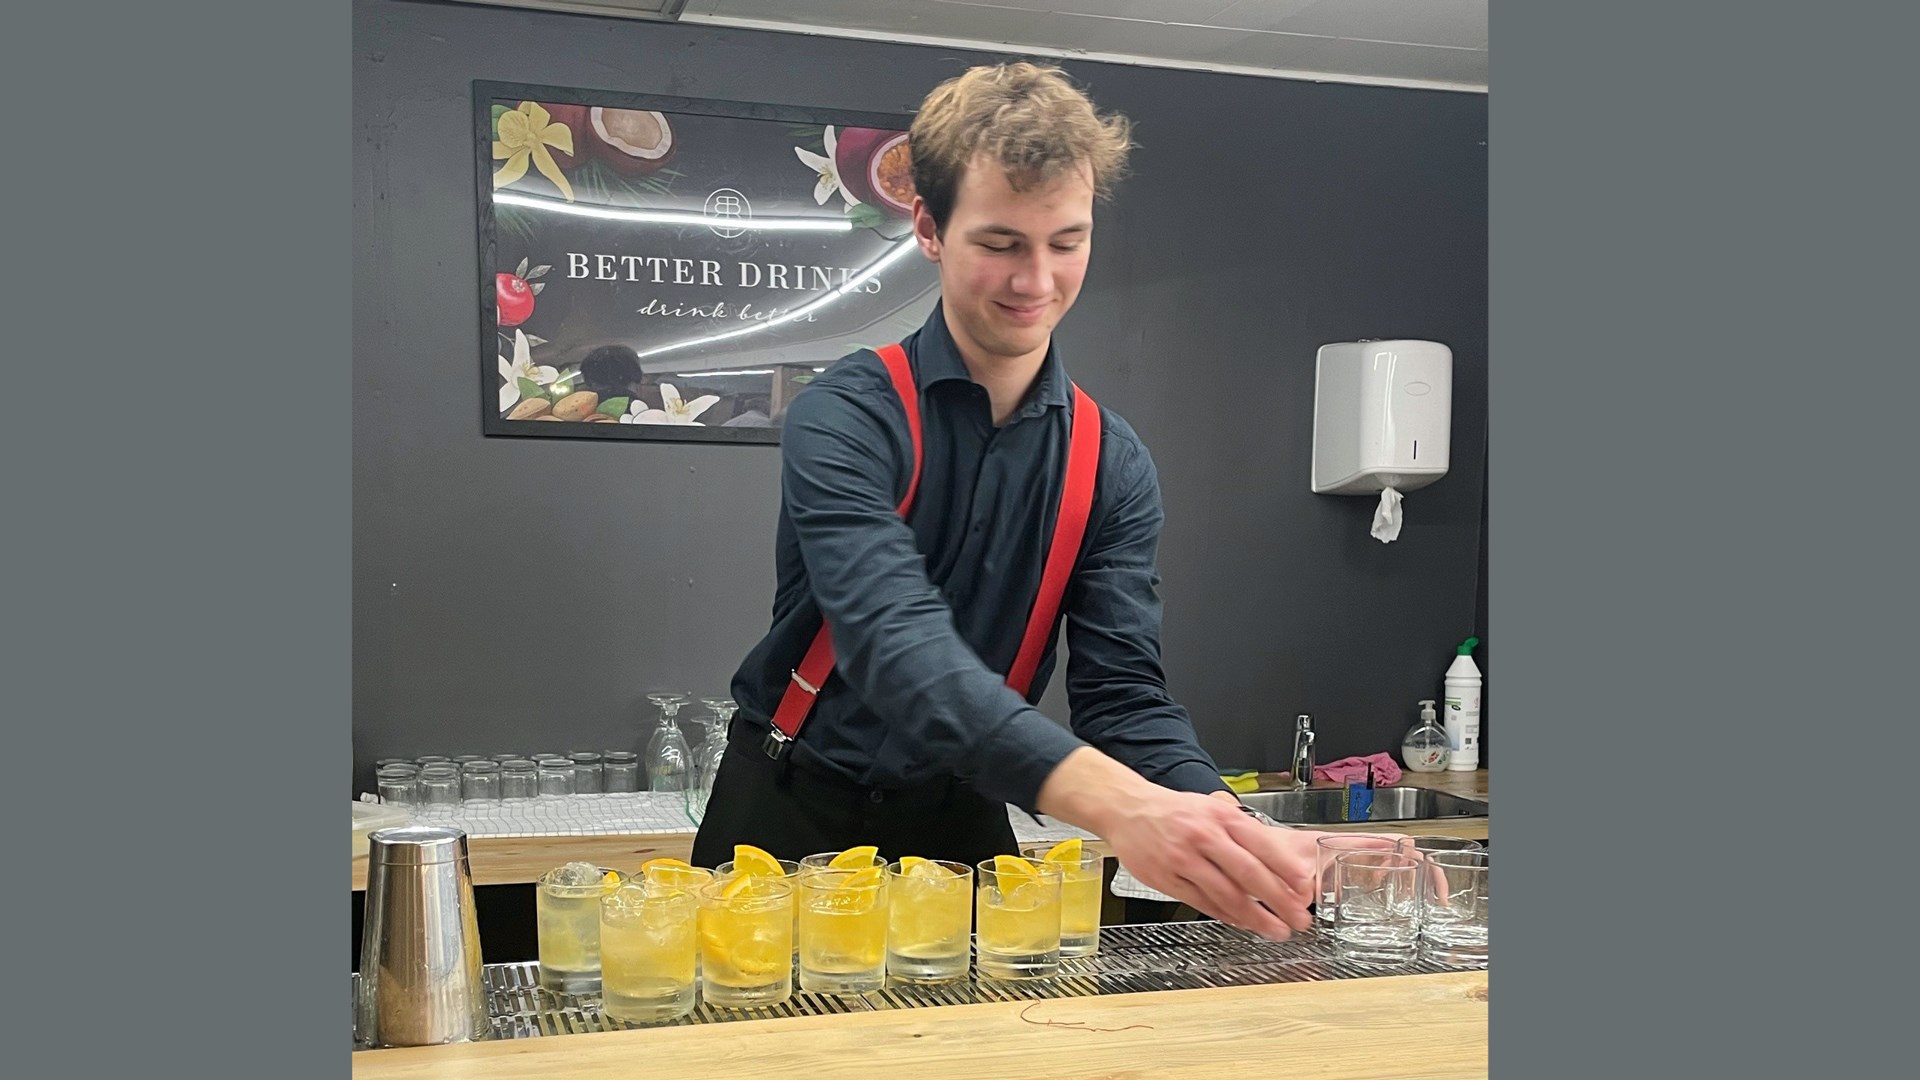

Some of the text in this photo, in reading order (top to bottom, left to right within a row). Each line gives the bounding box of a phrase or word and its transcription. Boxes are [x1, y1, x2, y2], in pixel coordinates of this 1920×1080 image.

[566, 252, 882, 294] BETTER DRINKS
[636, 299, 818, 323] drink bettr
